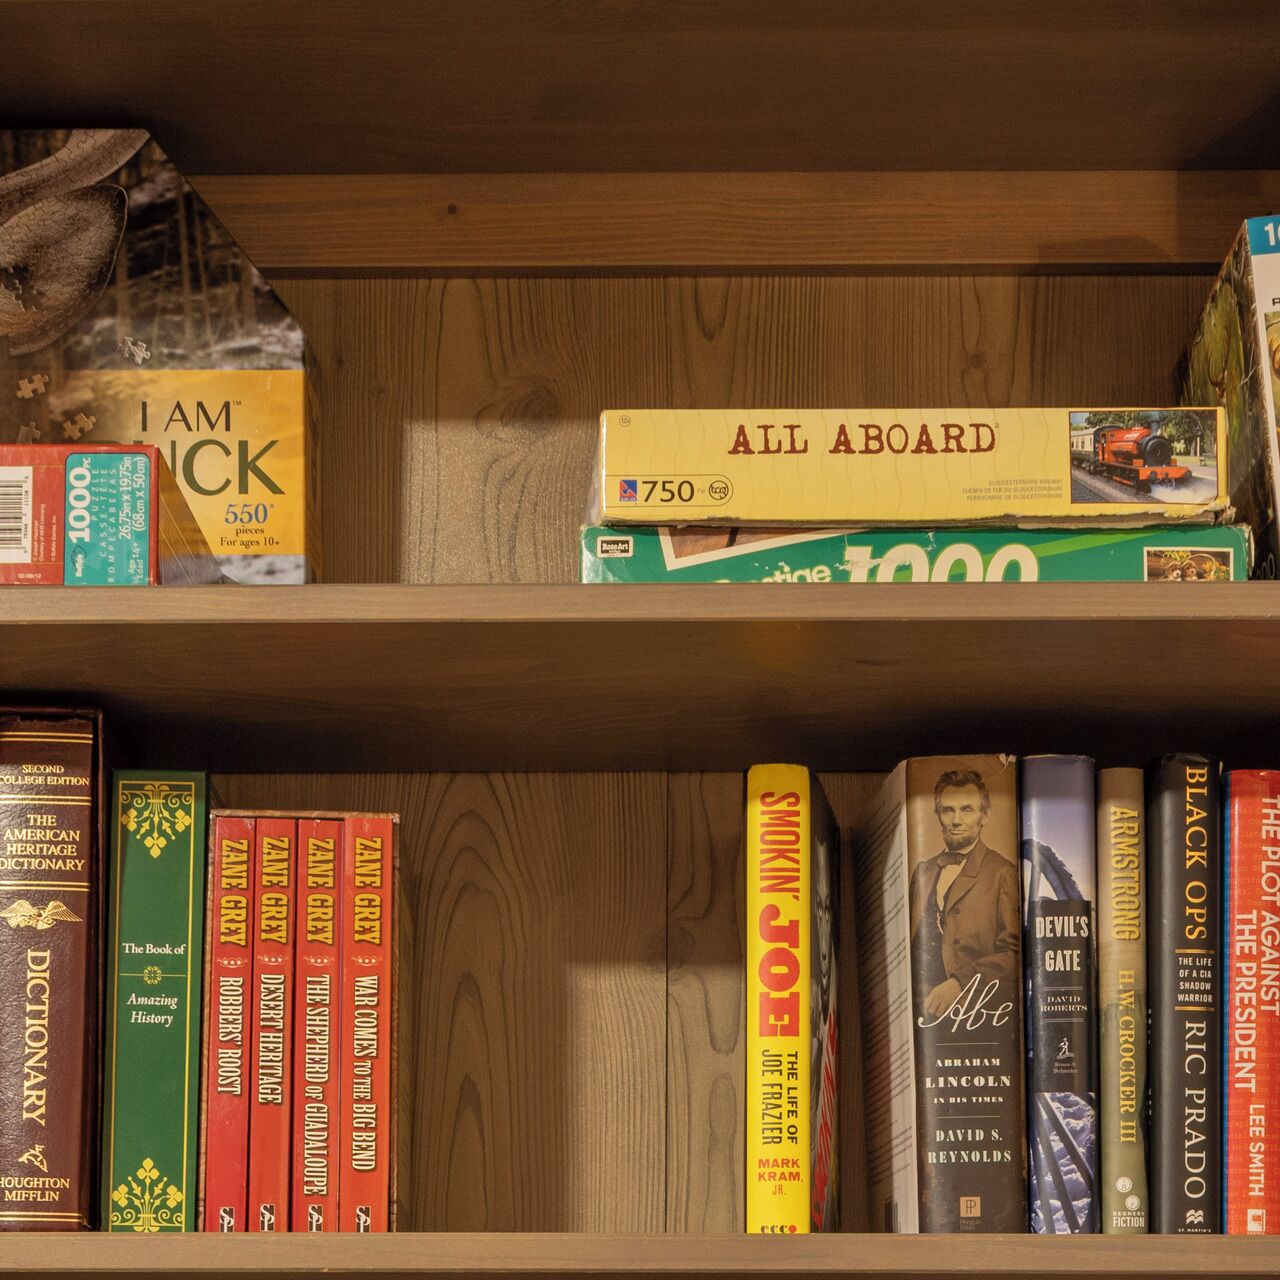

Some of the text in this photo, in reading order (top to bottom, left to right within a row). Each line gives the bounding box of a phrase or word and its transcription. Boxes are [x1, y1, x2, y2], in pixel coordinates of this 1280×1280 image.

[141, 401, 231, 432] I AM
[728, 424, 996, 454] ALL ABOARD
[642, 480, 694, 502] 750
[108, 469, 116, 582] ROMPECABEZAS
[224, 503, 268, 524] 550
[220, 536, 280, 549] For ages 10+
[236, 525, 264, 536] pieces
[27, 815, 56, 826] THE
[4, 830, 80, 842] AMERICAN
[6, 844, 77, 856] HERITAGE
[1186, 766, 1208, 940] BLACK OPS
[1110, 805, 1140, 940] ARMSTRONG
[759, 792, 800, 1037] SMOKIN' JOE
[1260, 795, 1280, 1016] THE PLOT AGAINST
[1035, 916, 1089, 938] DEVIL'S
[122, 943, 186, 954] The Book of
[1045, 950, 1081, 972] GATE
[218, 839, 248, 1094] ZANE GREY ROBBERS' ROOST
[259, 836, 288, 1103] ZANE GREY DESERT HERITAGE
[126, 993, 178, 1009] Amazing
[352, 837, 381, 1170] ZANE GREY WAR COMES TO THE BIG BEND
[918, 973, 1013, 1032] Abe
[1234, 909, 1257, 1093] THE PRESIDENT
[131, 1011, 173, 1027] History
[304, 838, 334, 1195] ZANE GREY THE SHEPHERD OF GUADALOUPE
[22, 949, 50, 1126] DICTIONARY
[936, 1058, 1001, 1067] ABRAHAM
[1119, 1015, 1136, 1114] CROCKER
[925, 1075, 1011, 1089] LINCOLN
[762, 1050, 782, 1145] JOE FRAZIER
[1184, 1021, 1206, 1198] RIC PRADO
[936, 1129, 1003, 1142] DAVID S.
[1120, 1120, 1137, 1142] III
[928, 1150, 1012, 1164] REYNOLDS
[1248, 1104, 1265, 1196] LEE SMITH
[4, 1190, 60, 1202] MIFFLIN
